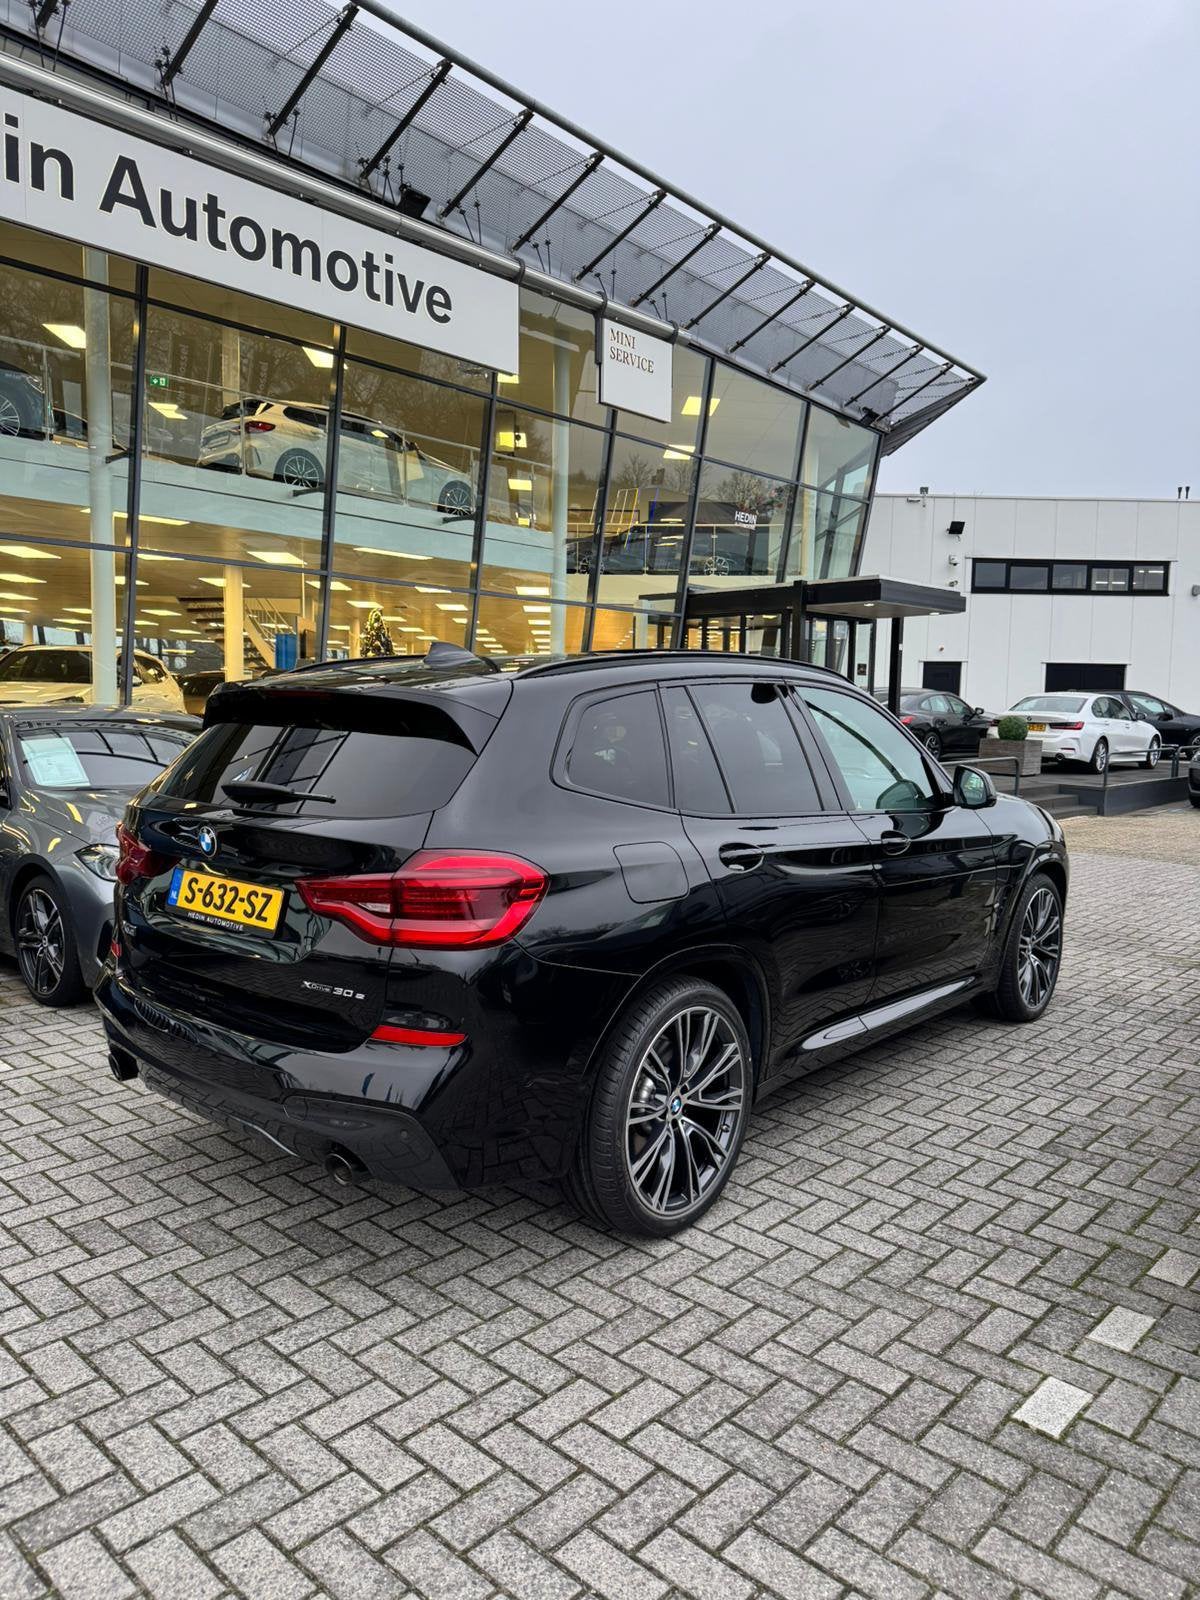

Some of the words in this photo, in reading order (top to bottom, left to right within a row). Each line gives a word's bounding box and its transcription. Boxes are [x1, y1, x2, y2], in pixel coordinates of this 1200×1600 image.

[3, 112, 75, 202] in
[98, 154, 454, 326] Automotive
[610, 328, 636, 349] MINI
[609, 346, 655, 374] SERVICE
[734, 510, 758, 525] HEDIN
[183, 876, 273, 922] S-632-SZ
[187, 911, 206, 922] HEDIN
[206, 916, 245, 931] AUTOMOTIVE
